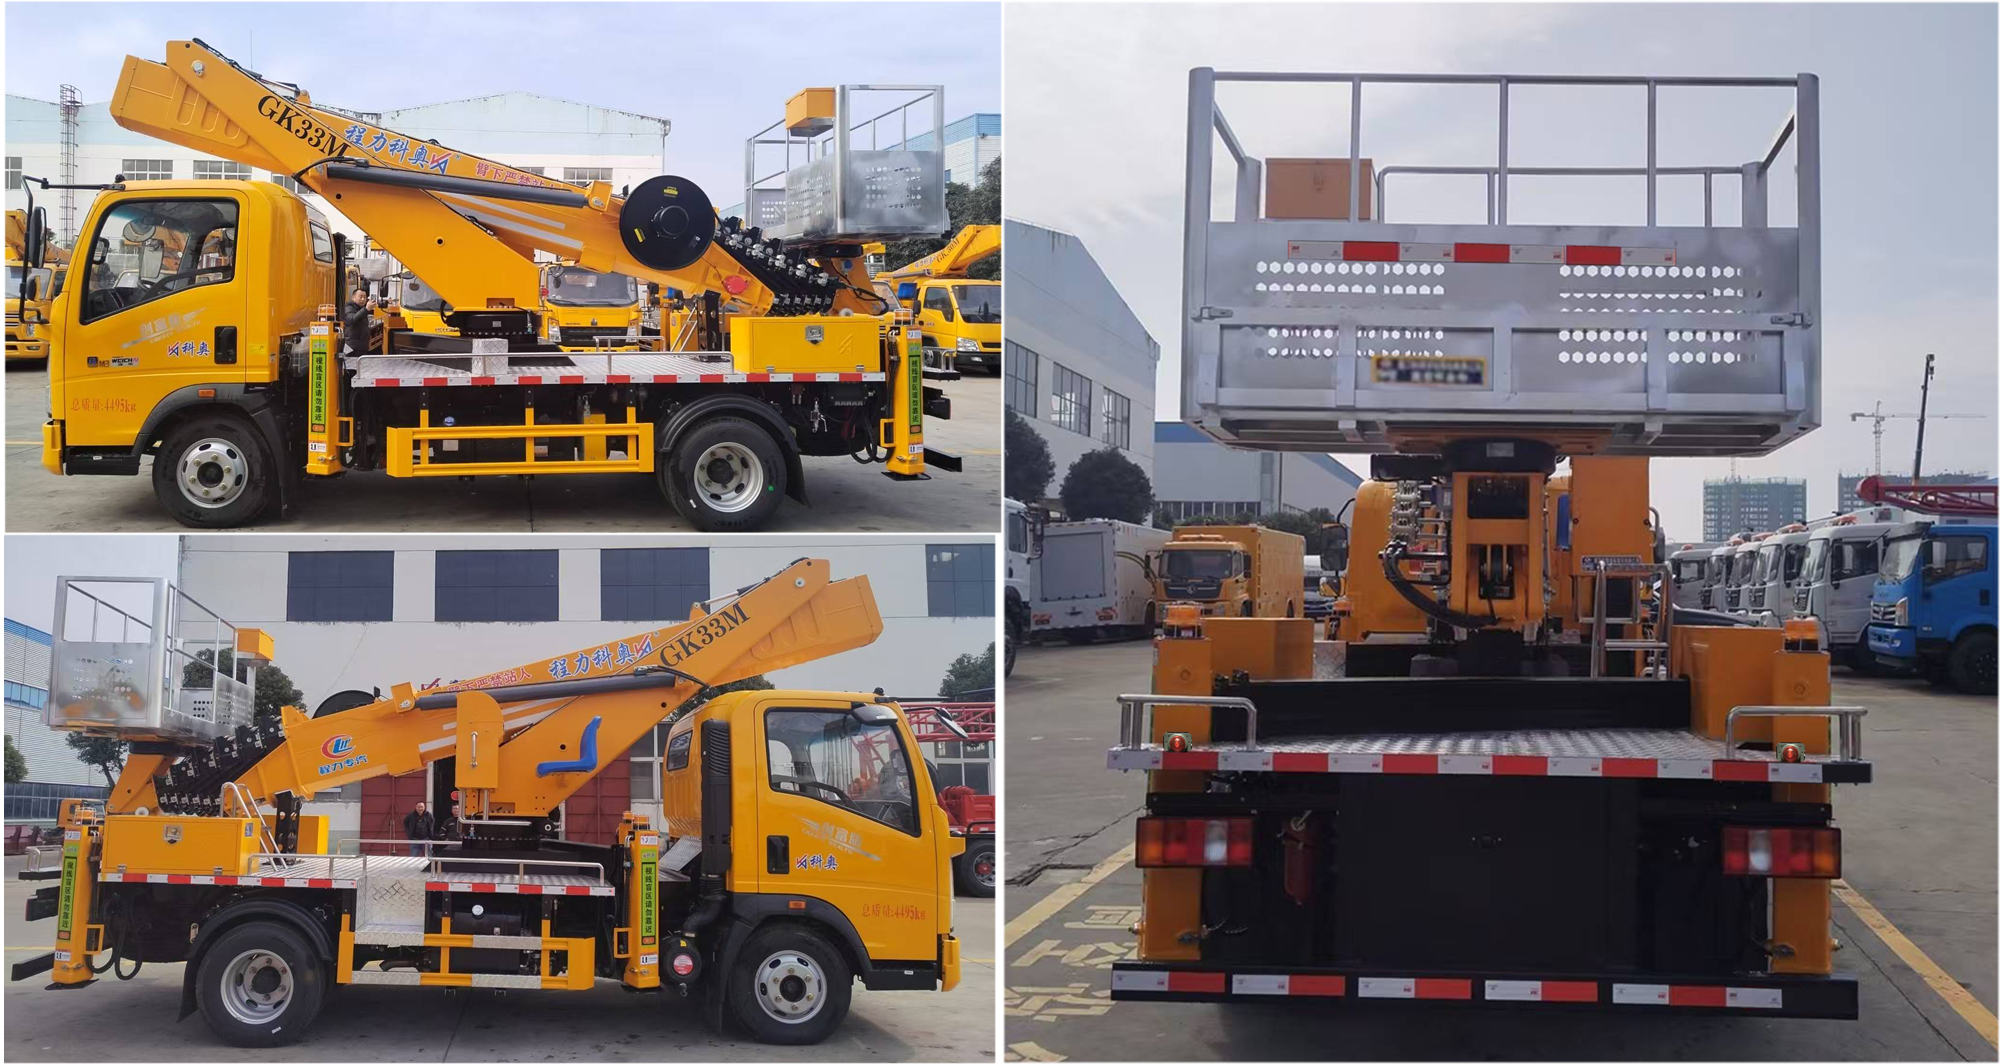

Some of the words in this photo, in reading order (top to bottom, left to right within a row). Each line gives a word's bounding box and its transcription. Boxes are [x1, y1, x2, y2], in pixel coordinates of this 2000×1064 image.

[257, 94, 352, 158] GK33M
[343, 124, 430, 169] 程力科奥
[181, 341, 211, 357] 科奥
[315, 356, 323, 422] 视线盲区请勿靠近
[659, 602, 751, 668] GK33M
[549, 642, 636, 680] 程力科奥
[318, 754, 369, 775] 程力专汽
[809, 854, 838, 870] 科奥
[645, 867, 653, 934] 视线盲区请勿靠近
